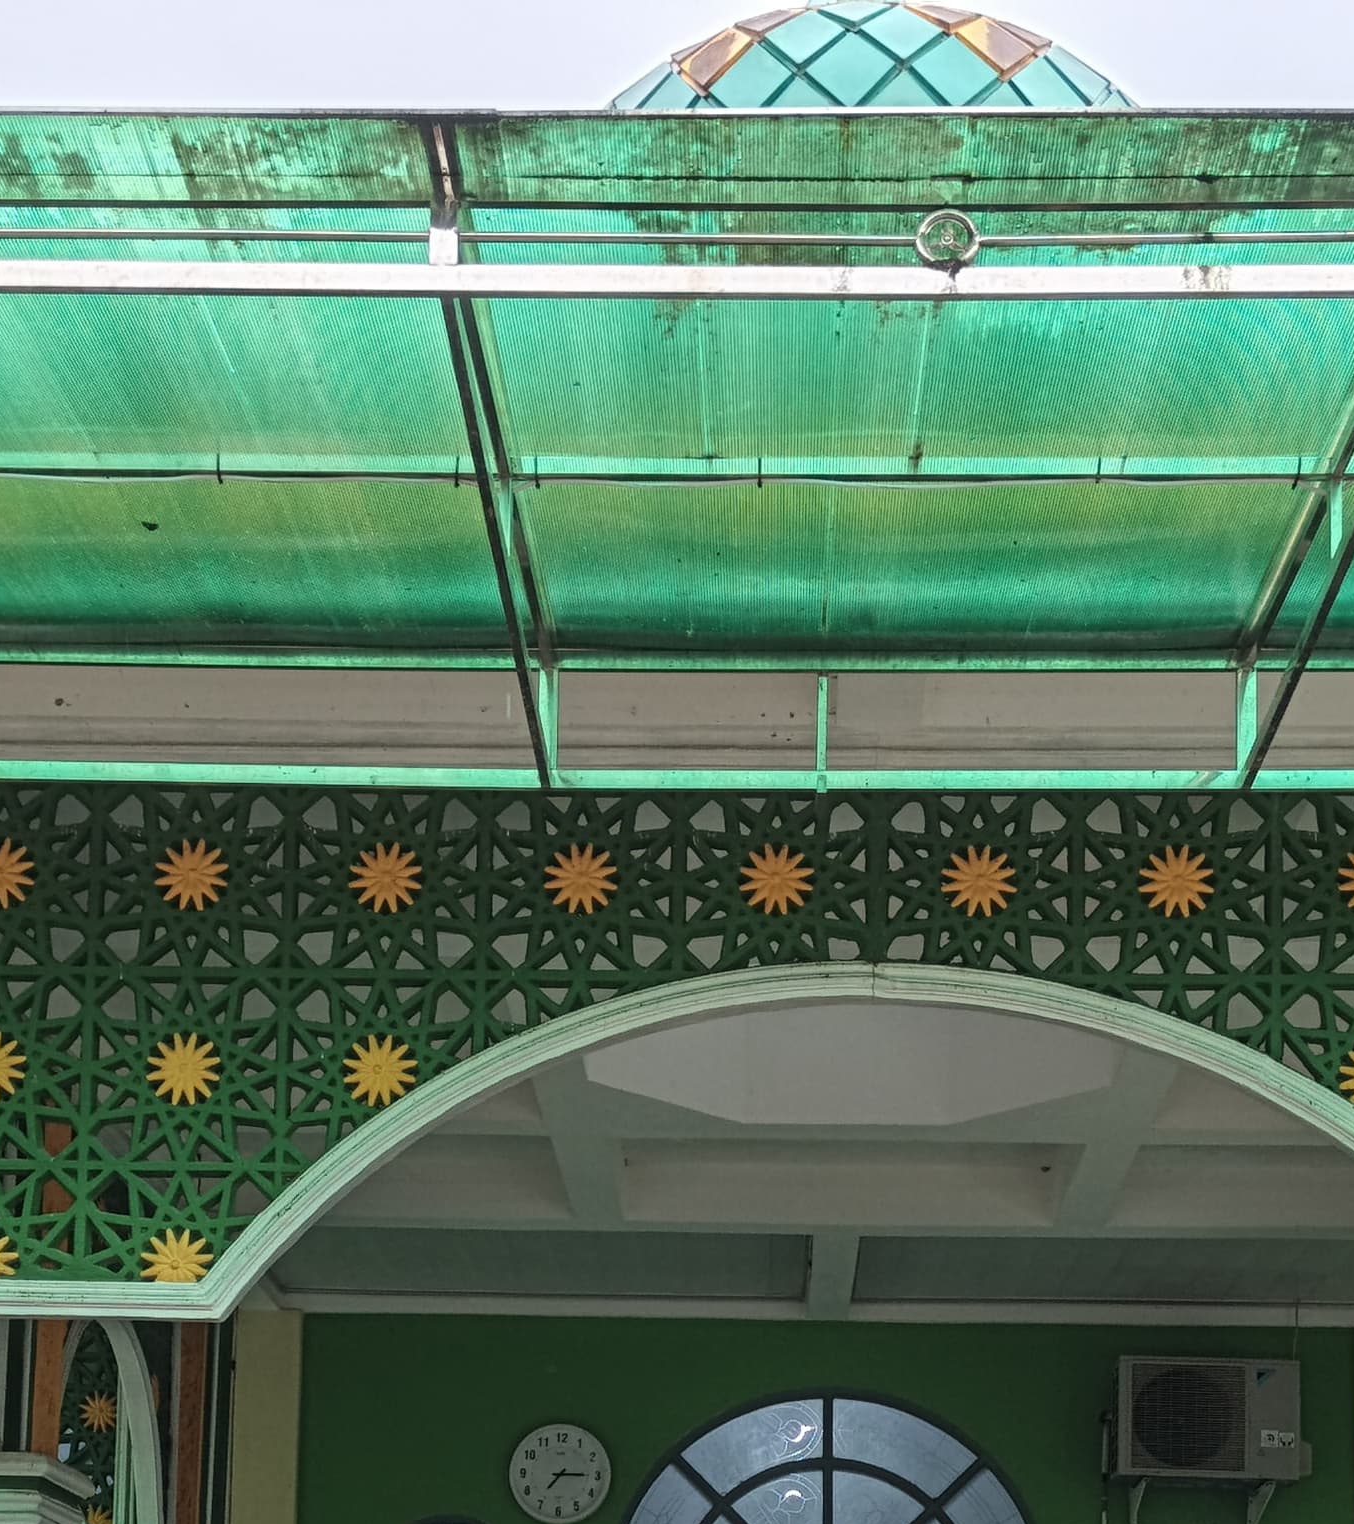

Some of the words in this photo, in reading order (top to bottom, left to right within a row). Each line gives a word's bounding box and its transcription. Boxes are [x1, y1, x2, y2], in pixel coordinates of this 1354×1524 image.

[538, 1437, 549, 1447] 11
[557, 1433, 568, 1443] 12
[578, 1438, 582, 1448] 1
[525, 1450, 536, 1460] 10
[590, 1452, 596, 1462] 2
[520, 1468, 526, 1478] 9
[595, 1471, 601, 1481] 3
[525, 1485, 531, 1496] 8
[588, 1488, 594, 1498] 4
[538, 1500, 543, 1509] 7
[573, 1501, 580, 1511] 5
[555, 1506, 562, 1517] 6
